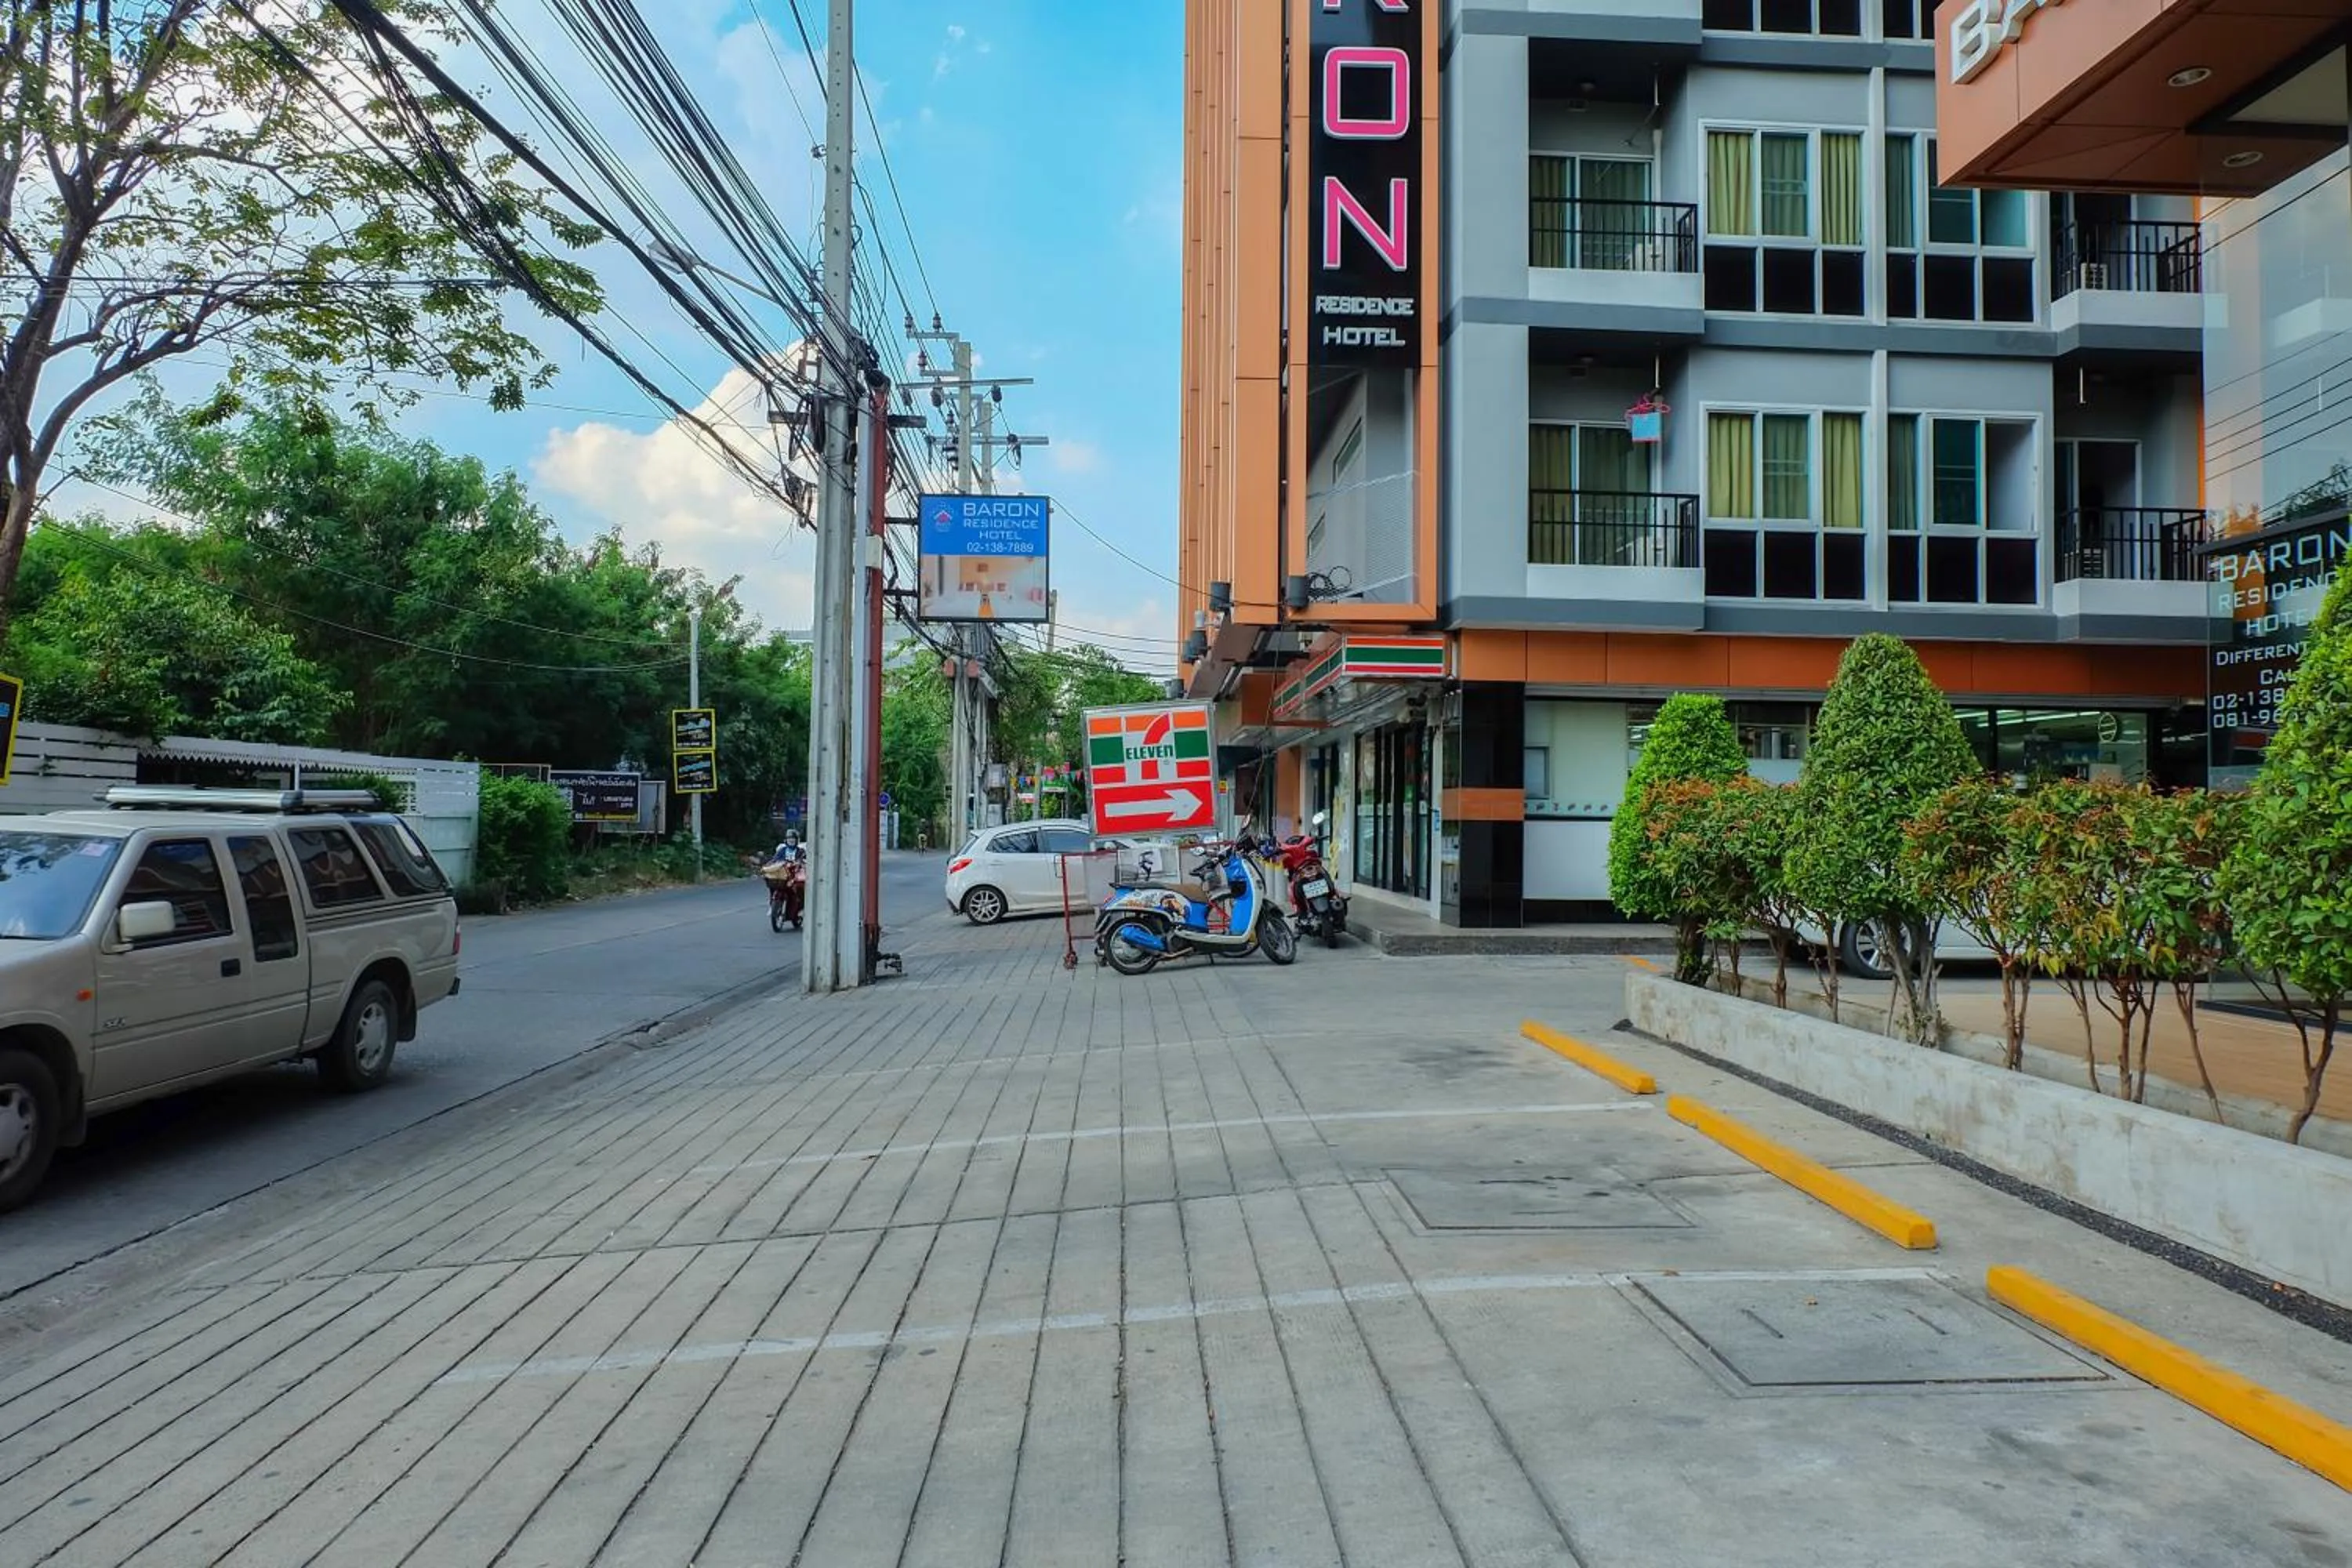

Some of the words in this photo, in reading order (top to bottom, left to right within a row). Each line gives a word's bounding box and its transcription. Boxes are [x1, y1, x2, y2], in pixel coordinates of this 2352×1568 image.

[1322, 0, 1410, 272] ON
[1316, 296, 1414, 315] RESIDENCE
[1323, 325, 1406, 347] HOTEL
[964, 503, 1040, 517] BARON
[964, 518, 1039, 529] RESIDENCE
[979, 531, 1022, 540] HOTEL
[967, 542, 1034, 553] 02-138-7889
[2220, 529, 2352, 583] BARON
[2218, 571, 2338, 612] RESIDENC
[2246, 608, 2310, 637] HOTE
[2260, 669, 2297, 685] CAL
[2213, 688, 2285, 710] 02-138
